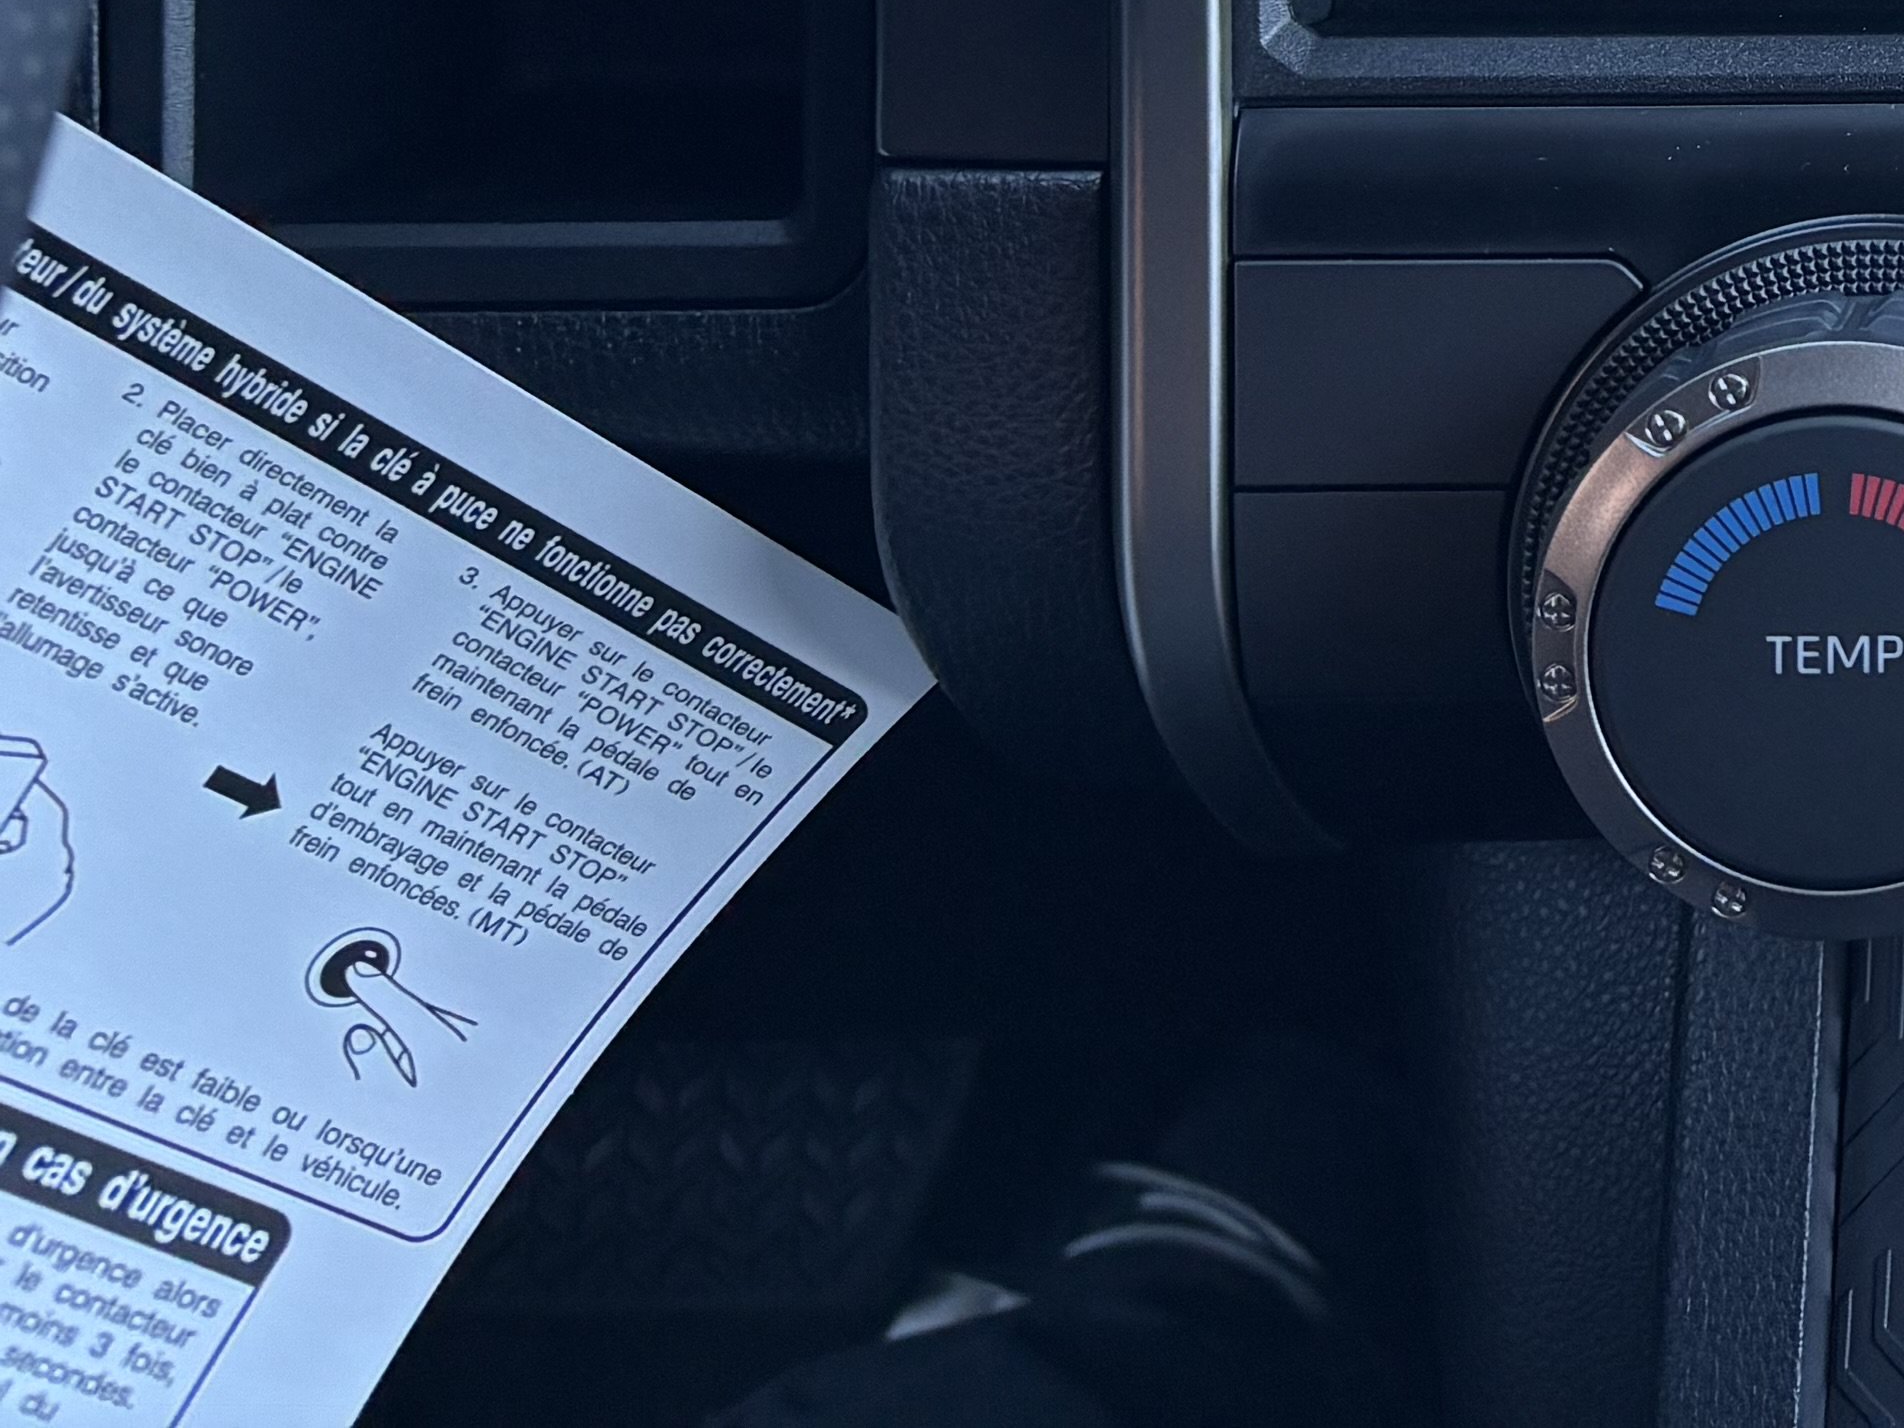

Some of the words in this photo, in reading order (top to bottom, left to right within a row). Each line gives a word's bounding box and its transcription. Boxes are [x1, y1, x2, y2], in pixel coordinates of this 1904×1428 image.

[94, 475, 187, 530] START
[112, 303, 216, 371] système
[214, 353, 308, 424] hybride
[308, 411, 345, 441] si
[337, 423, 370, 459] la
[370, 448, 419, 481] clé
[411, 463, 440, 496] à
[428, 484, 498, 530] puce
[498, 520, 535, 550] ne
[535, 535, 654, 617] fonctionne
[647, 609, 701, 645] pas
[114, 448, 141, 475] le
[147, 470, 269, 540] contacteur
[120, 382, 145, 408] 2.
[156, 399, 234, 451] Placer
[238, 449, 371, 528] directement
[374, 519, 400, 544] la
[136, 428, 177, 456] clé
[179, 447, 233, 488] bien
[238, 479, 259, 503] à
[260, 497, 313, 530] plat
[317, 526, 389, 570] contre
[72, 506, 196, 574] contacteur
[9, 587, 122, 650] retentisse
[129, 644, 159, 668] et
[163, 660, 210, 692] que
[142, 577, 176, 602] ce
[181, 596, 229, 628] que
[173, 629, 254, 677] sonore
[1766, 635, 1904, 674] TEMP
[458, 566, 480, 590] 3.
[488, 584, 585, 642] Appuyer
[588, 640, 628, 666] sur
[631, 660, 655, 683] le
[661, 681, 773, 746] contacteur
[580, 664, 665, 716] START
[411, 672, 463, 711] frein
[470, 707, 569, 770] enfoncée.
[576, 759, 630, 796] (AT)
[430, 653, 554, 725] maintenant
[556, 715, 581, 741] la
[582, 736, 660, 782] pédale
[666, 779, 697, 801] de
[451, 631, 567, 698] contacteur
[684, 753, 730, 788] tout
[733, 783, 764, 807] en
[369, 723, 467, 779] Appuyer
[469, 774, 511, 801] sur
[513, 792, 538, 816] le
[544, 812, 657, 875] contacteur
[461, 800, 548, 851] START
[288, 824, 341, 863] frein
[347, 856, 461, 921] enfoncées.
[467, 907, 529, 947] (MT)
[329, 772, 378, 808] tout
[382, 801, 414, 826] en
[419, 819, 543, 887] maintenant
[544, 874, 570, 901] la
[571, 893, 648, 937] pédale
[456, 872, 484, 893] et
[487, 881, 512, 907] la
[513, 900, 592, 944] pédale
[597, 938, 629, 962] de
[21, 1145, 93, 1196] cas
